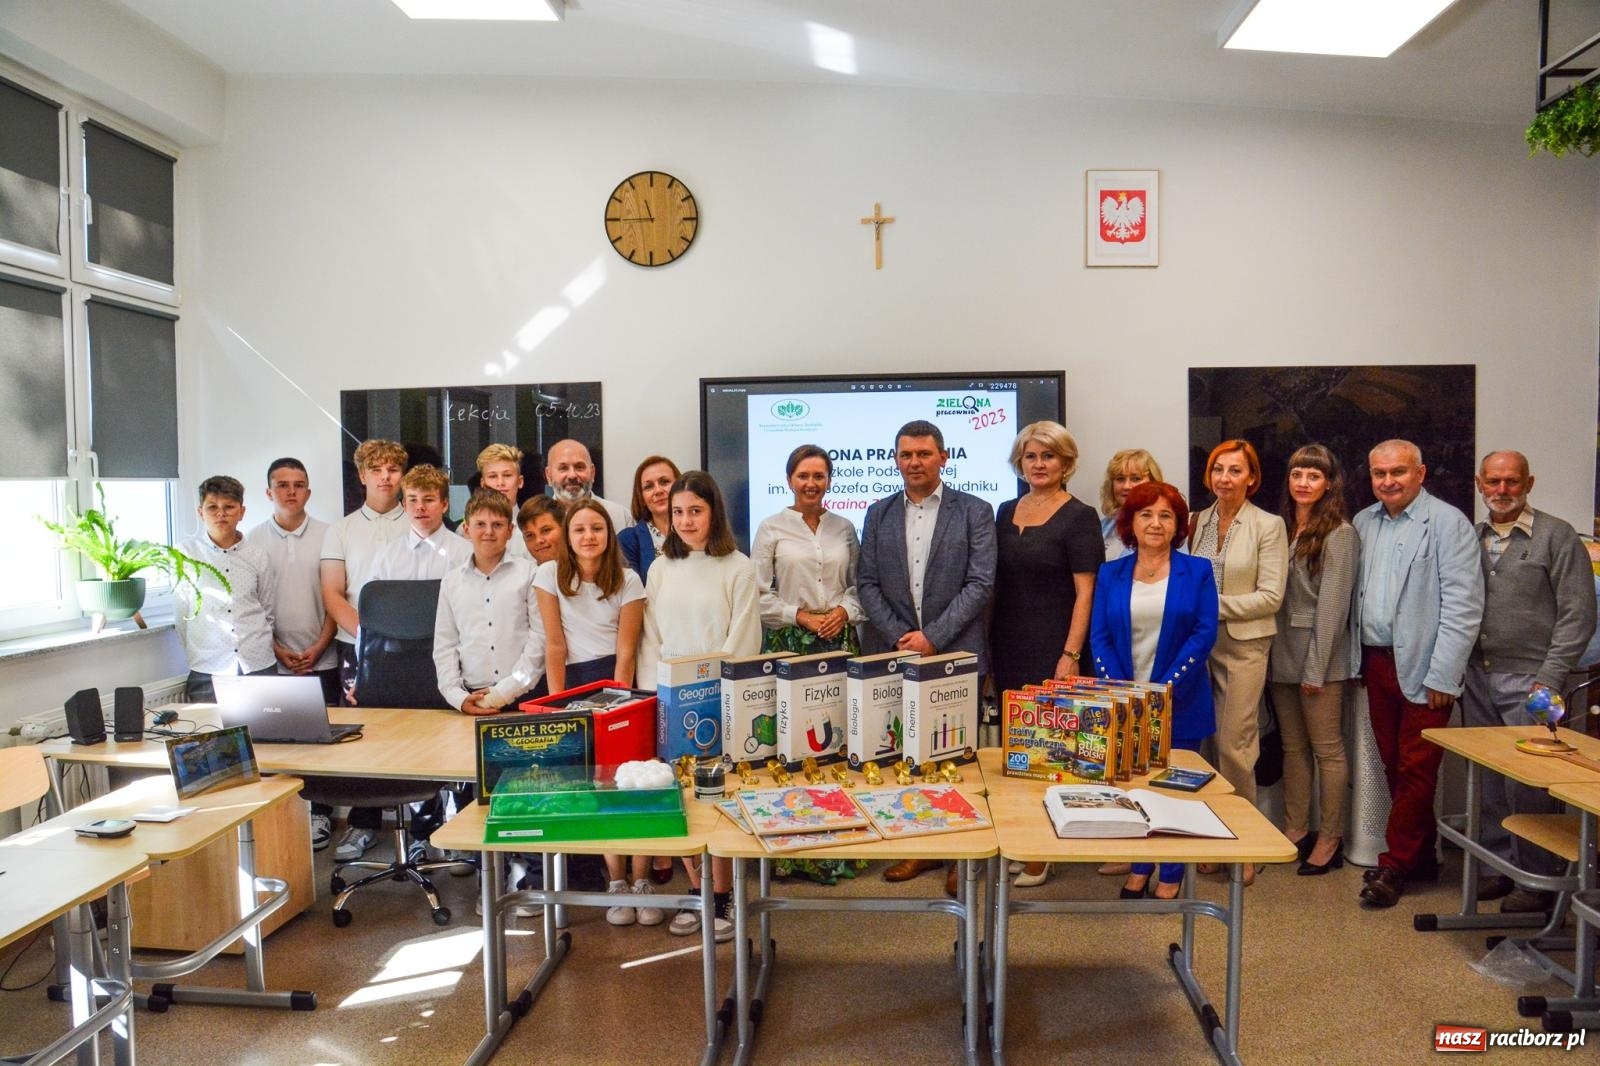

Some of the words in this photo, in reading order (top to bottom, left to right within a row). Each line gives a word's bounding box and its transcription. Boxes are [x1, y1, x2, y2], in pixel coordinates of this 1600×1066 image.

[936, 396, 992, 412] ZIELONA
[936, 409, 976, 417] pracownia
[831, 465, 864, 478] zkole
[768, 483, 788, 495] im.
[823, 499, 867, 510] Kraina
[678, 683, 720, 701] Geografi
[742, 689, 777, 702] Geogr
[805, 685, 840, 703] Fizyka
[872, 686, 903, 701] Biolog
[929, 686, 969, 704] Chemia
[658, 701, 667, 744] Geografia
[724, 693, 732, 741] Geografia
[780, 700, 788, 735] Fizyka
[851, 698, 860, 736] Biologia
[908, 700, 916, 739] Chemia
[1007, 702, 1080, 731] Polska
[491, 724, 536, 738] ESCAPE
[539, 721, 578, 735] ROOM
[515, 736, 554, 745] GEOGRAFIA
[1009, 753, 1028, 763] 200
